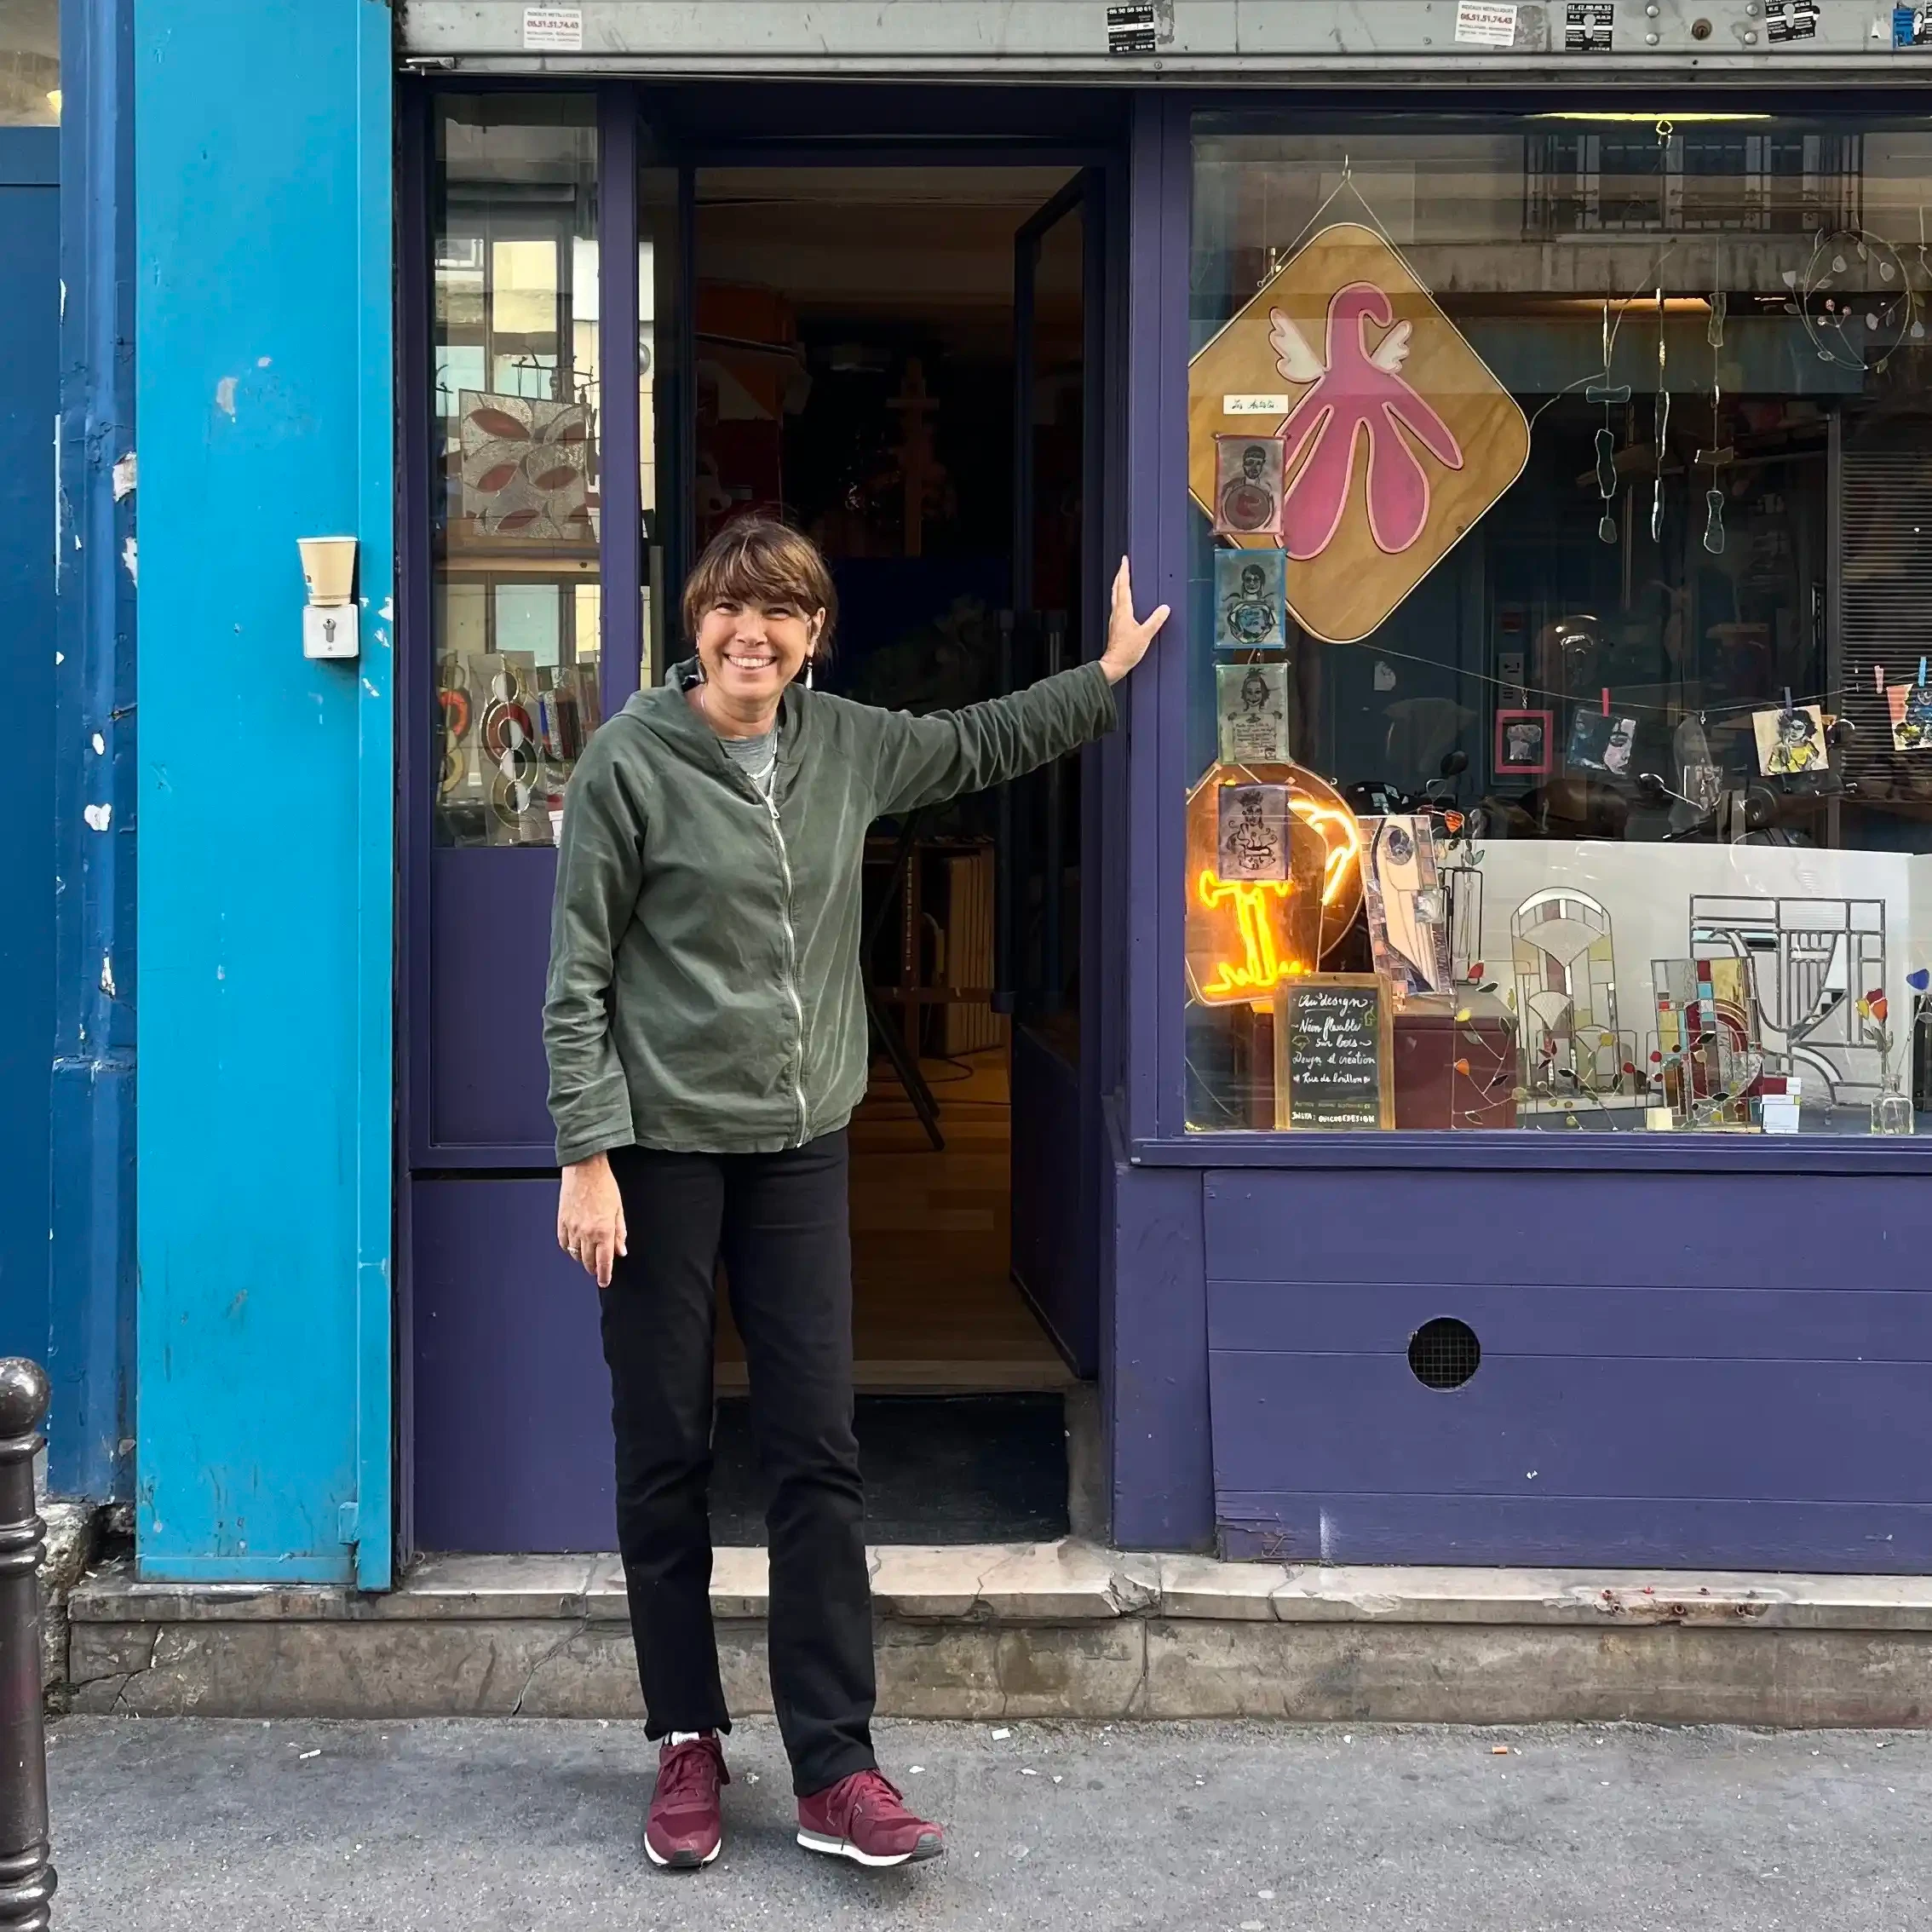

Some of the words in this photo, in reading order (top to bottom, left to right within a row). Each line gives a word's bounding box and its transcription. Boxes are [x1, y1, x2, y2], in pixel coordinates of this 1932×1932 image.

[1315, 1038, 1333, 1048] sur
[1336, 1033, 1358, 1048] bois
[1338, 1050, 1377, 1065] création
[1302, 1072, 1320, 1084] Rue
[1320, 1073, 1331, 1083] de
